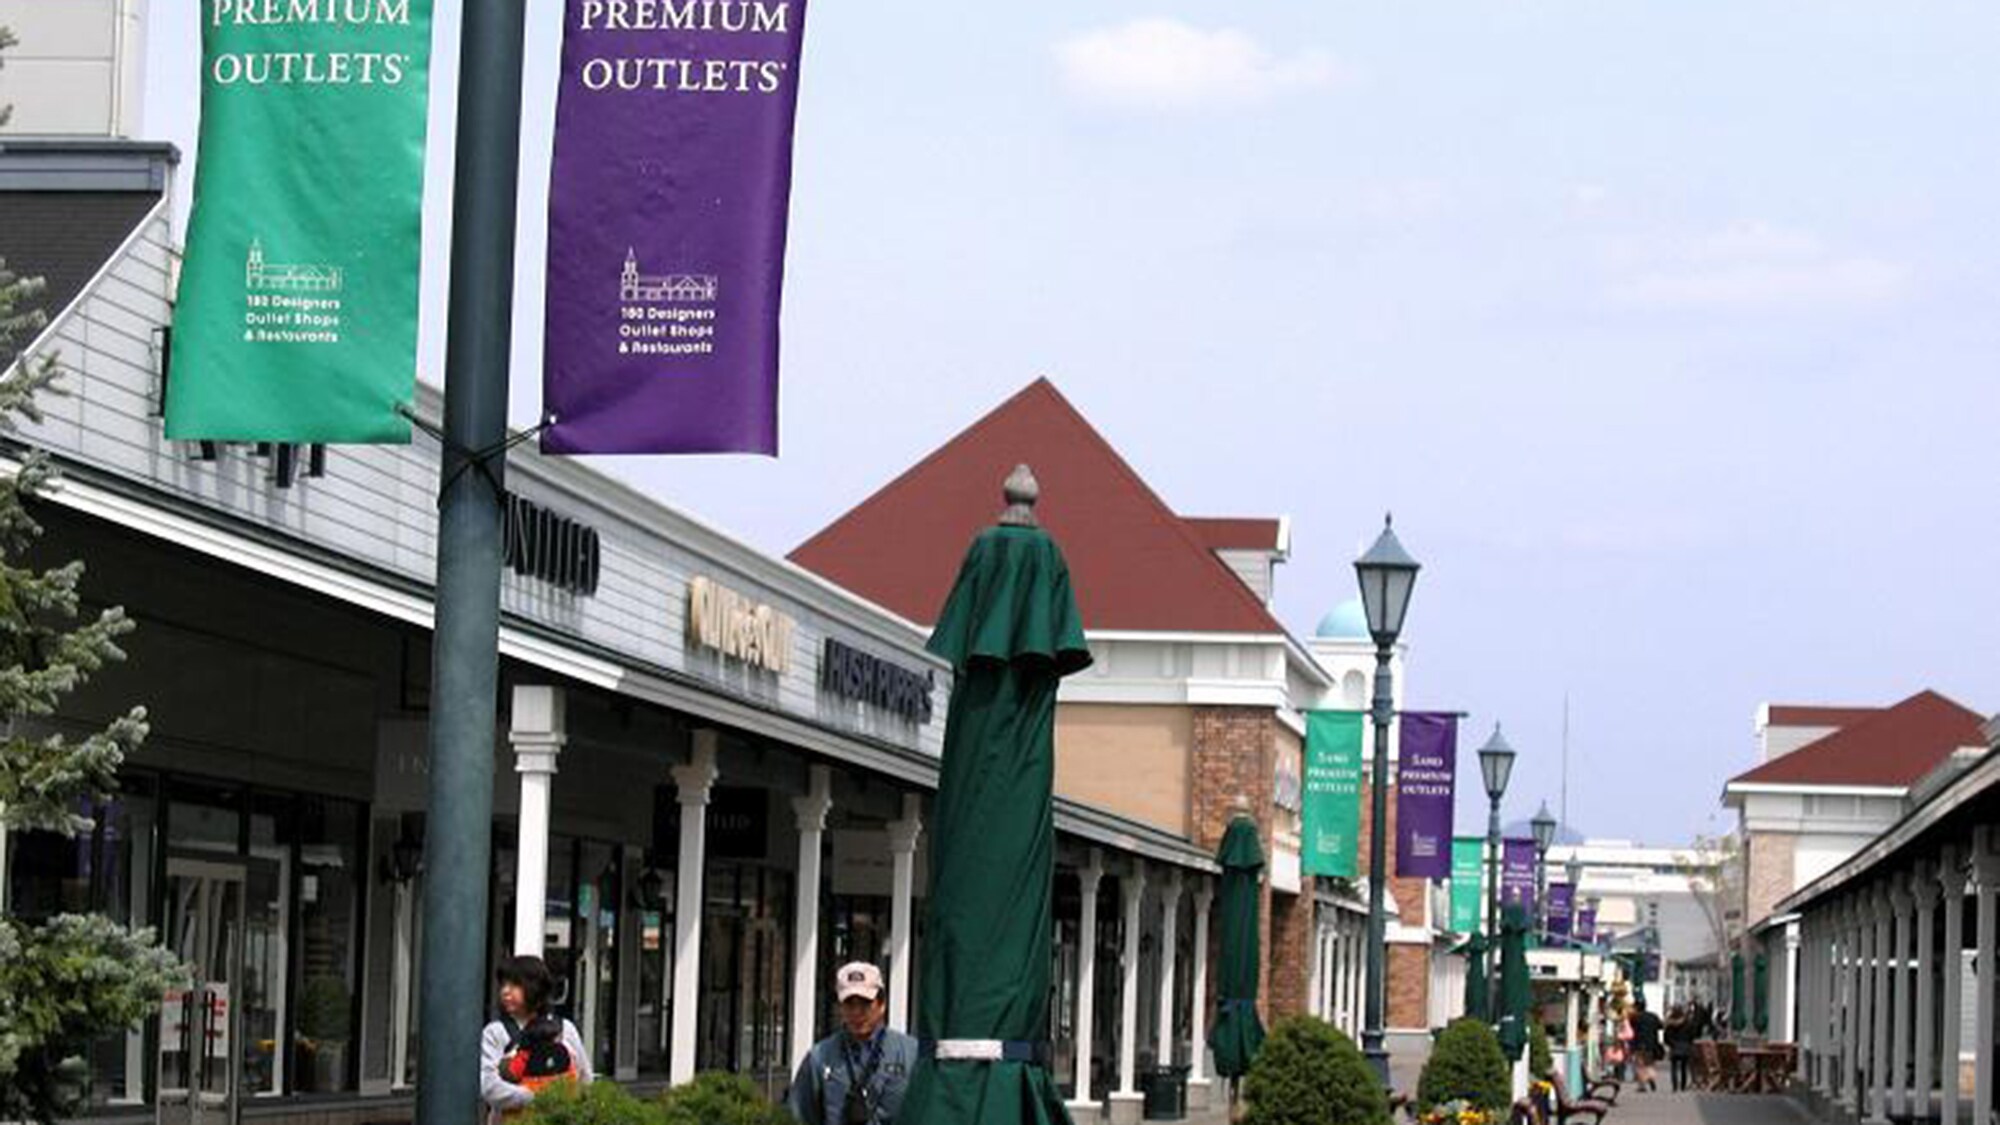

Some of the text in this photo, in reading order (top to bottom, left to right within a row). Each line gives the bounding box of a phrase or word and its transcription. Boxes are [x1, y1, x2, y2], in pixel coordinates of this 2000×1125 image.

[212, 0, 411, 25] PREMIUM
[581, 0, 789, 33] PREMIUM
[213, 52, 404, 85] OUTLETS
[582, 58, 781, 92] OUTLETS
[271, 295, 341, 311] Designers
[246, 312, 339, 327] Outlet Shops
[646, 307, 716, 322] Designers
[256, 330, 338, 343] Restaurants
[619, 324, 714, 338] Outlet Shops
[631, 342, 713, 354] Restaurants
